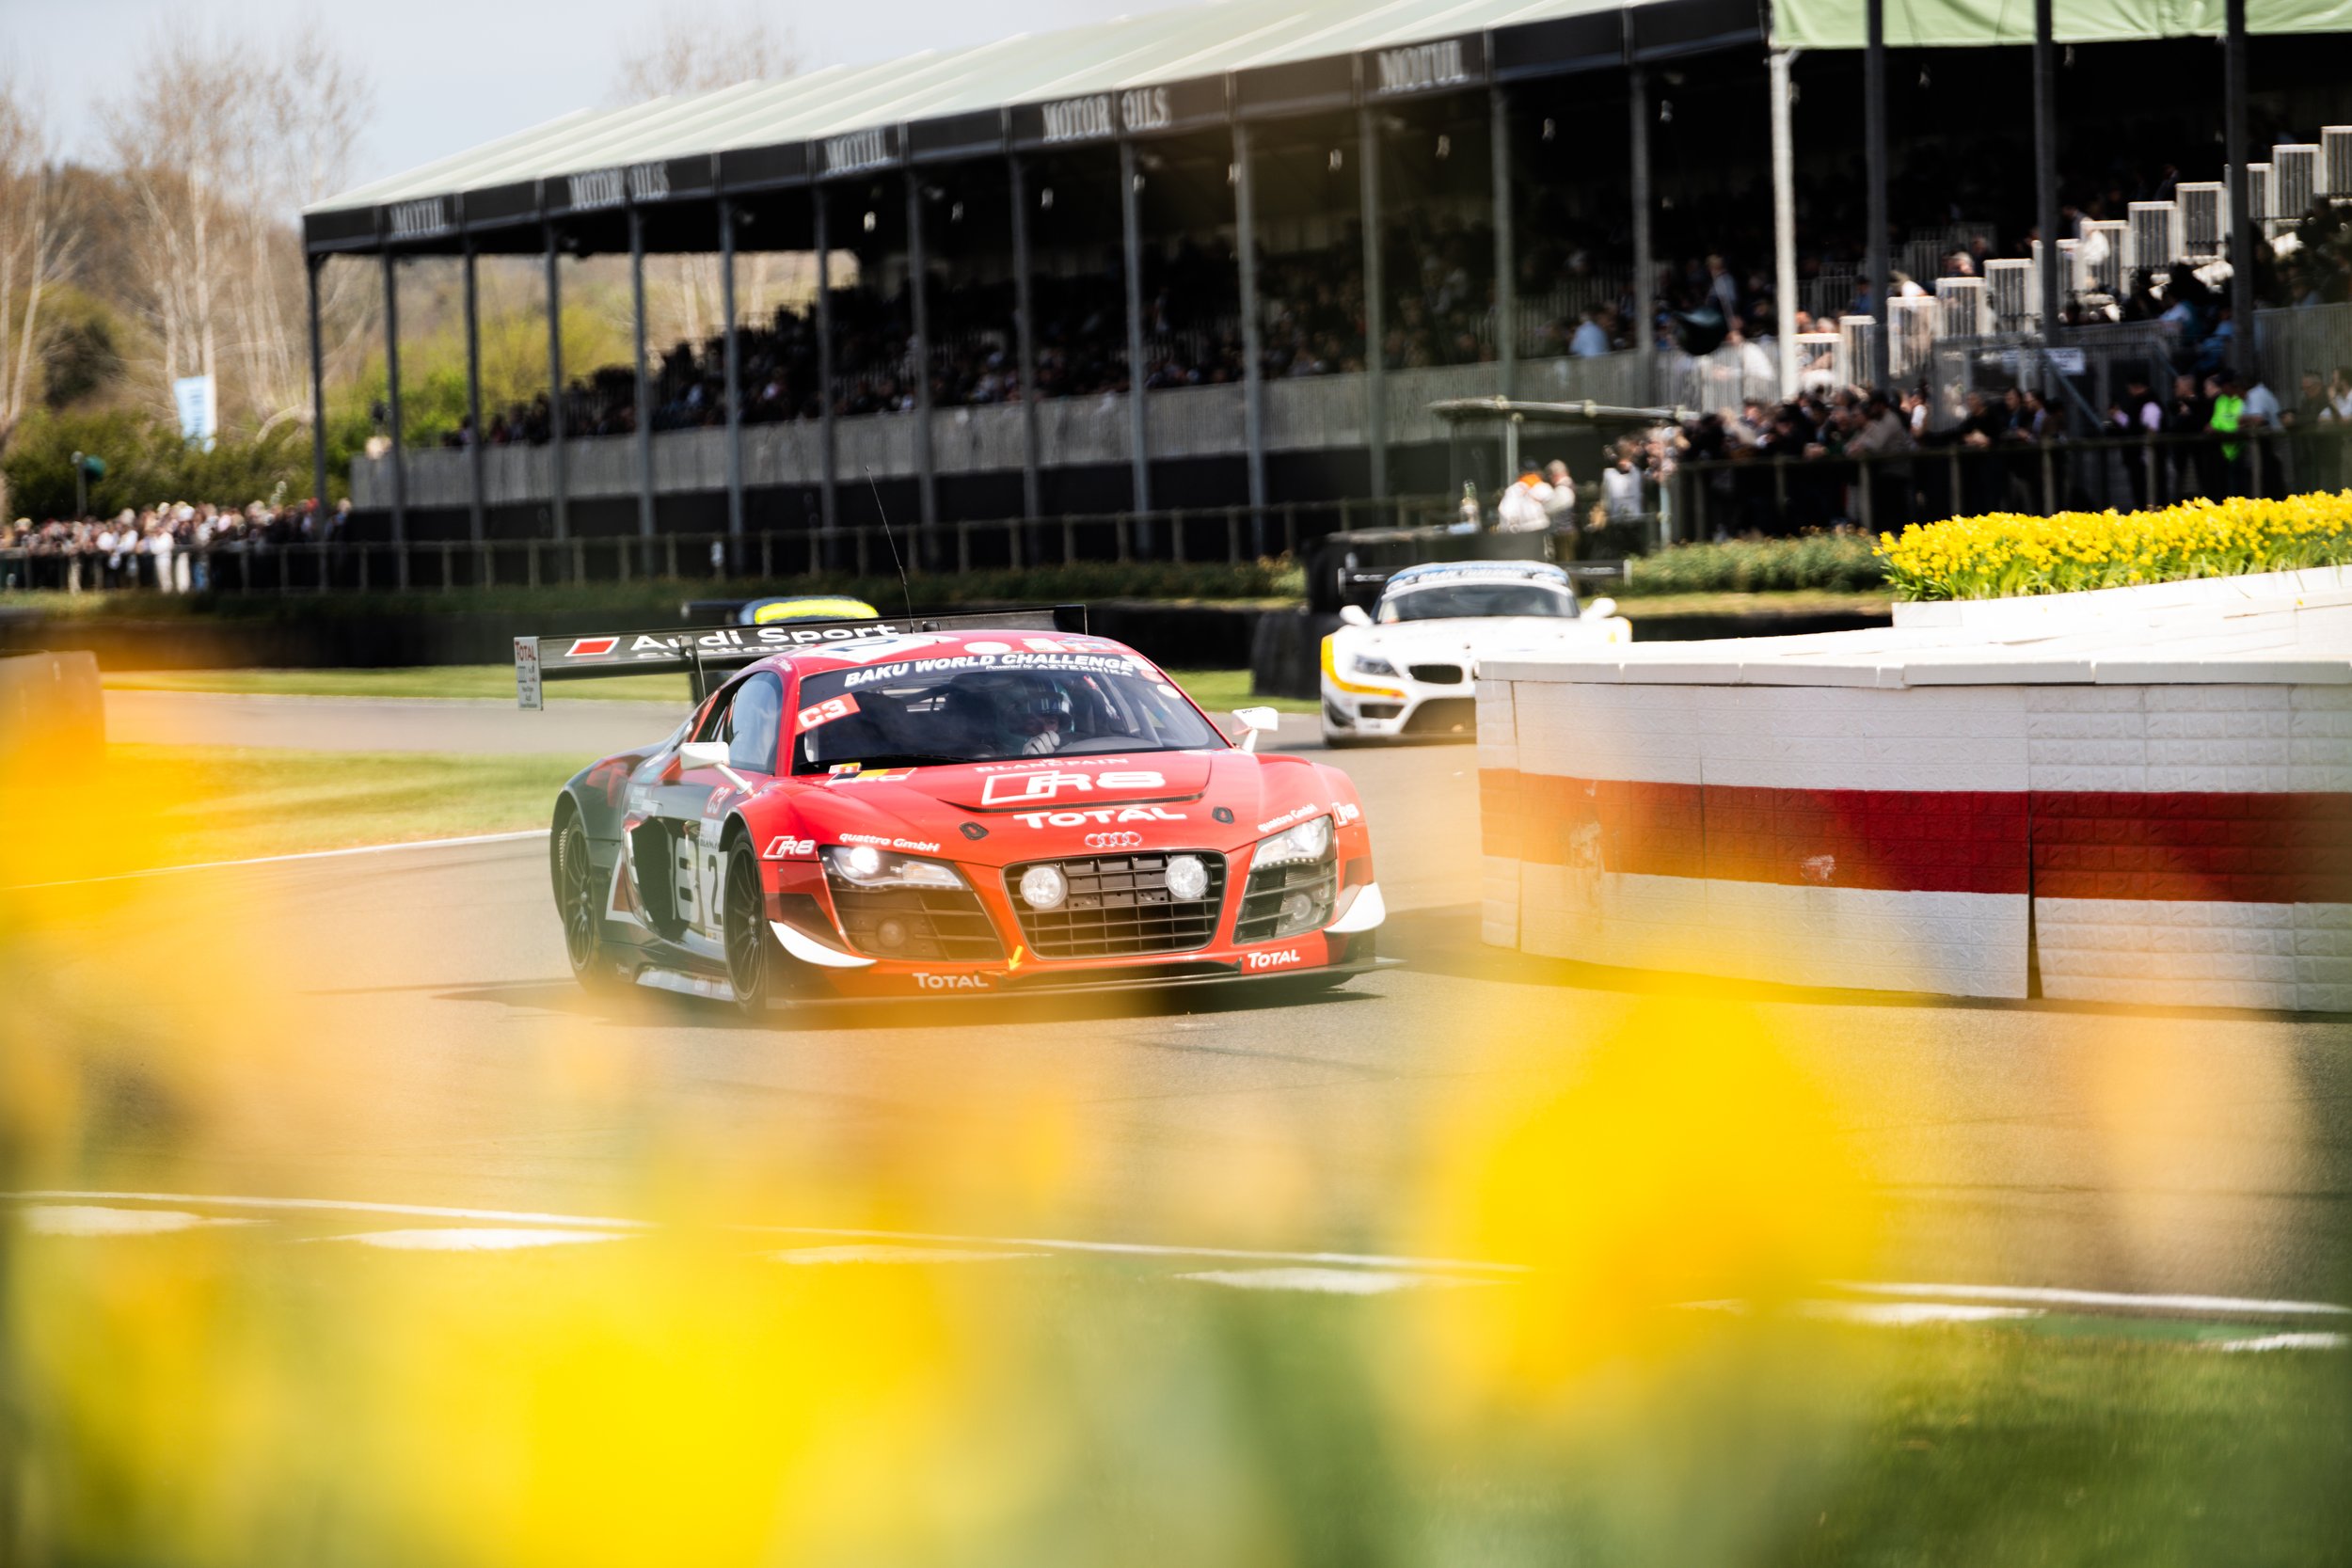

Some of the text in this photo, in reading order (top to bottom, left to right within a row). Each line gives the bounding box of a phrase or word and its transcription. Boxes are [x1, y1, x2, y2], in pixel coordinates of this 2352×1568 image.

[1042, 95, 1112, 144] MOTOR
[630, 630, 741, 651] Audi
[756, 623, 900, 643] Sport
[515, 641, 537, 661] TOTAL
[844, 653, 1135, 688] BAKU WORLD CHALLENGE
[798, 698, 847, 728] C3
[975, 757, 1130, 774] BLANCPAIN
[1024, 769, 1167, 798] R8
[706, 785, 732, 815] C3
[1012, 807, 1188, 830] TOTAL
[1257, 802, 1319, 833] quattro GmbH
[775, 836, 817, 857] R8
[838, 832, 941, 853] quattro GmbH
[1247, 948, 1301, 969] TOTAL
[912, 972, 990, 990] TOTAL
